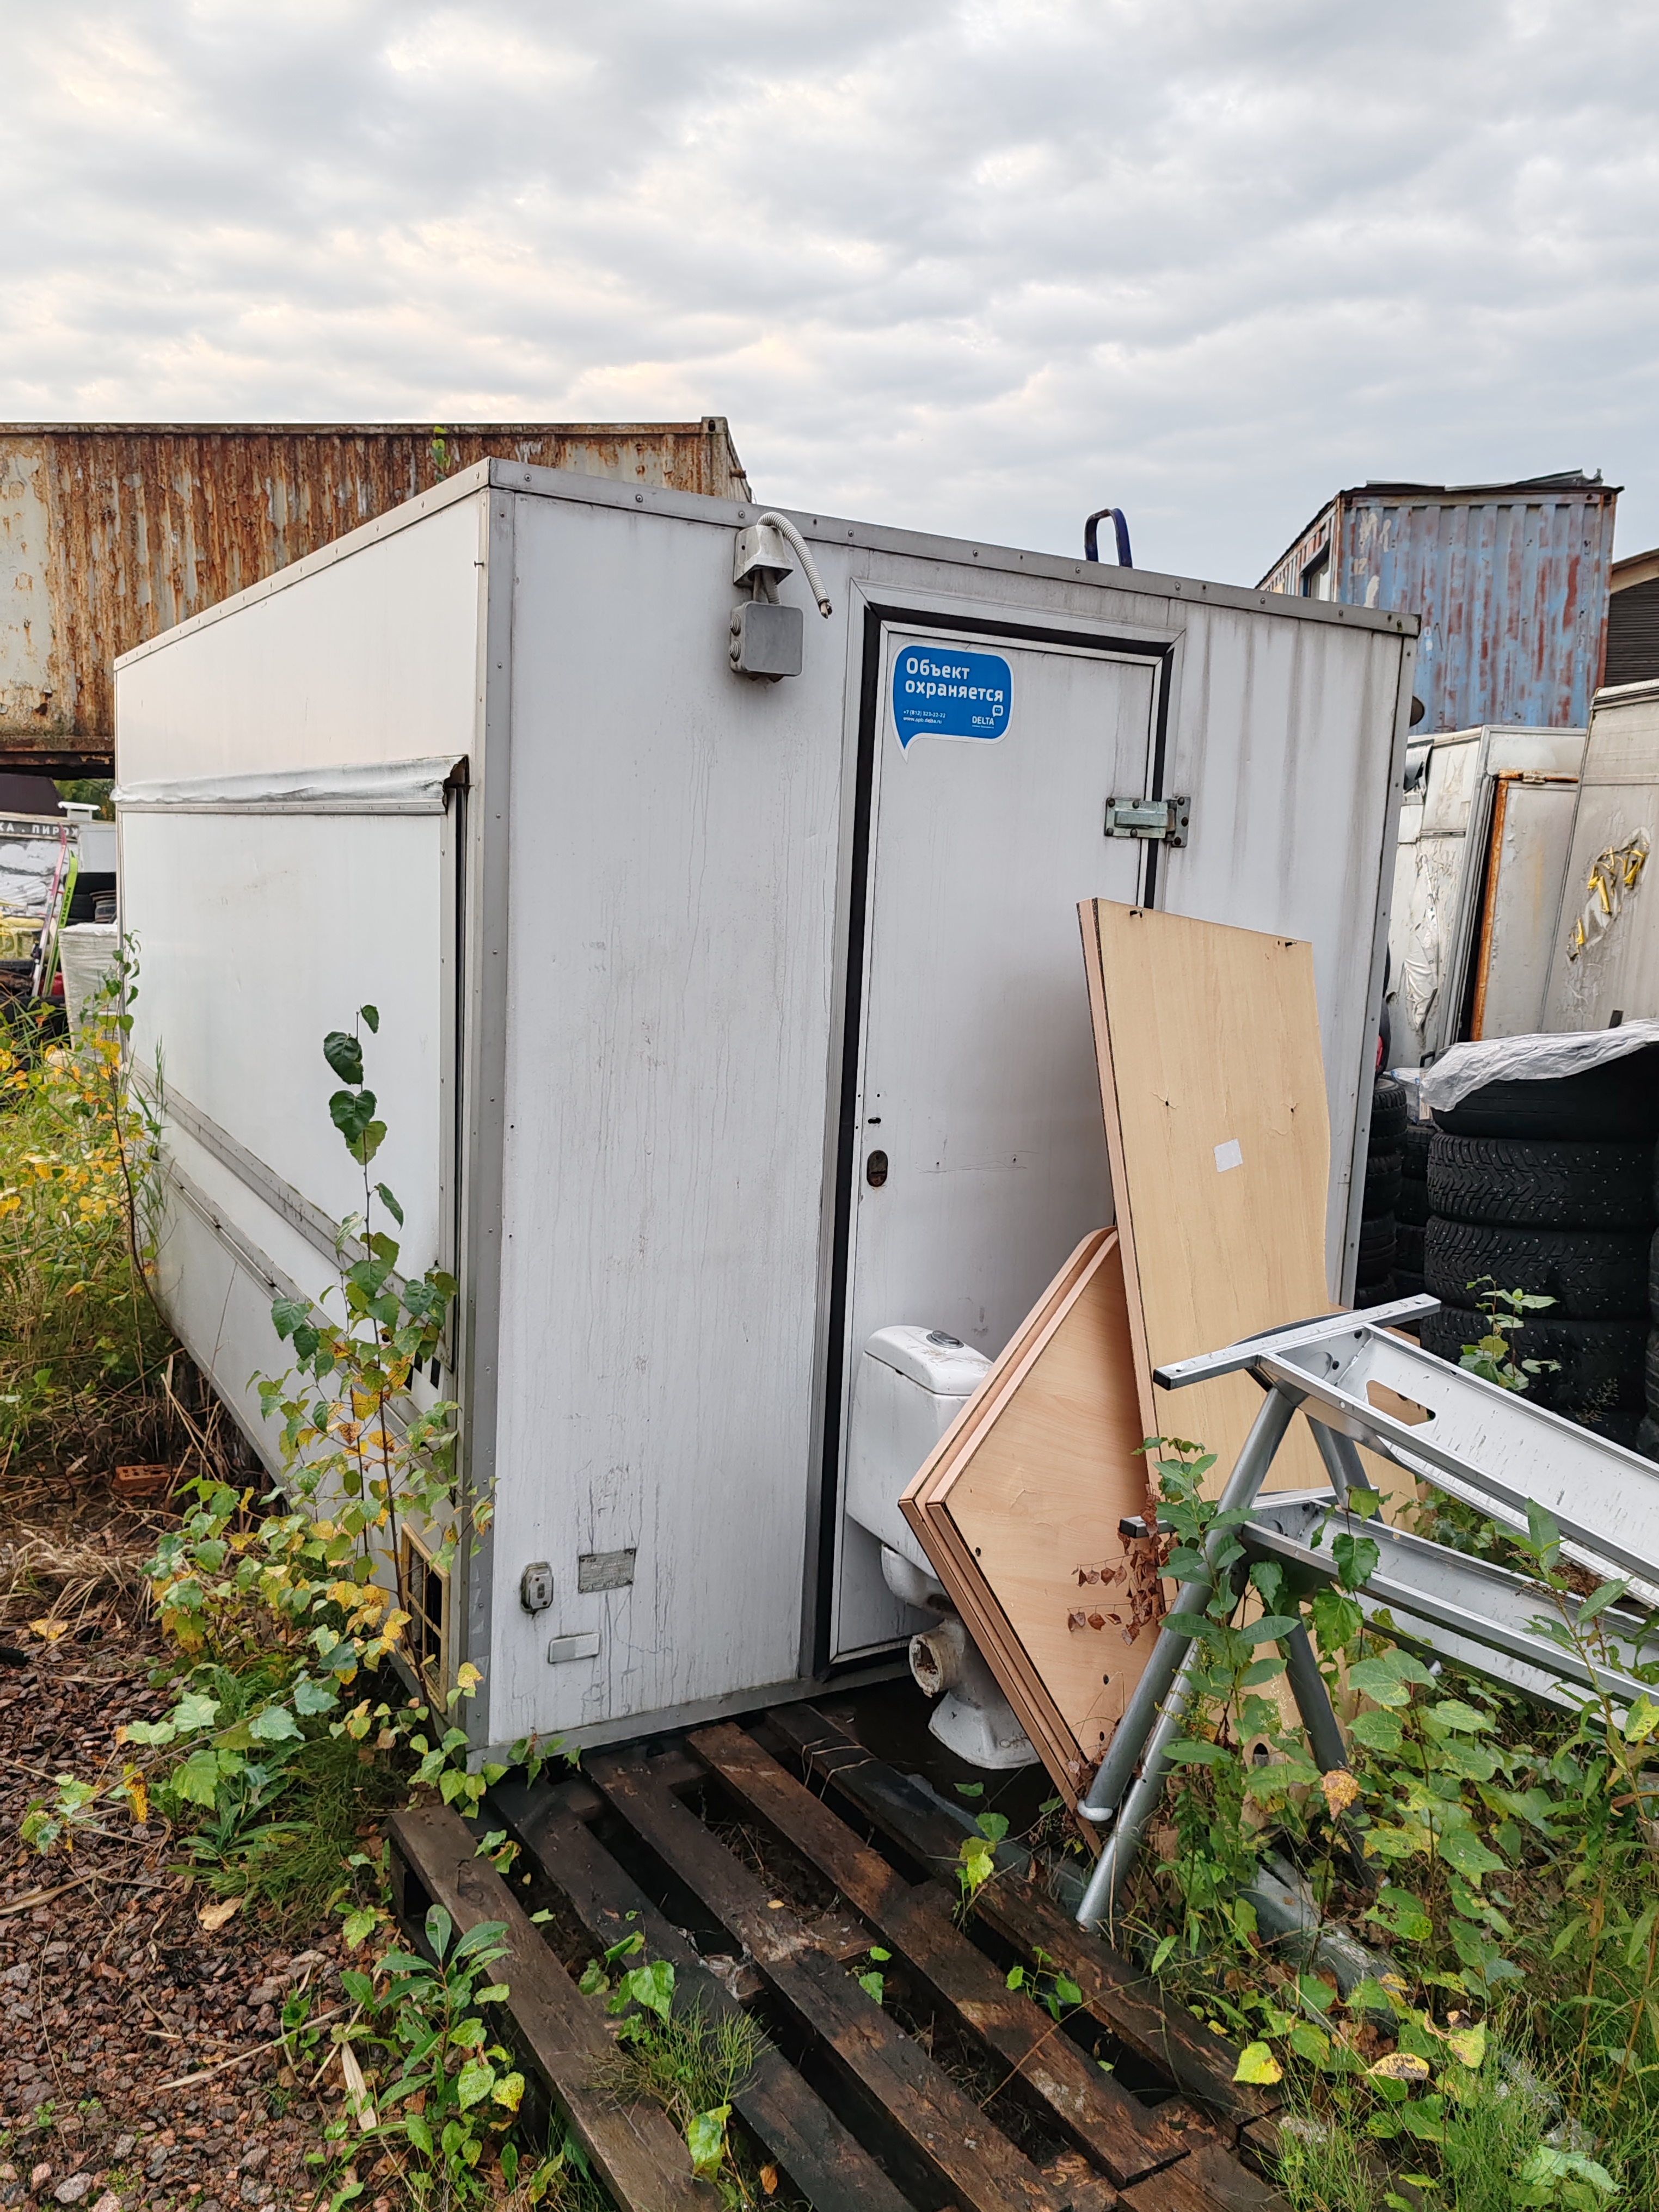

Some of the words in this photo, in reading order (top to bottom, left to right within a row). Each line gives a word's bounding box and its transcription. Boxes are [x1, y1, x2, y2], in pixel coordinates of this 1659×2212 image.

[906, 657, 970, 680] Объект
[905, 680, 1003, 703] охраняется
[972, 716, 994, 726] DELTA
